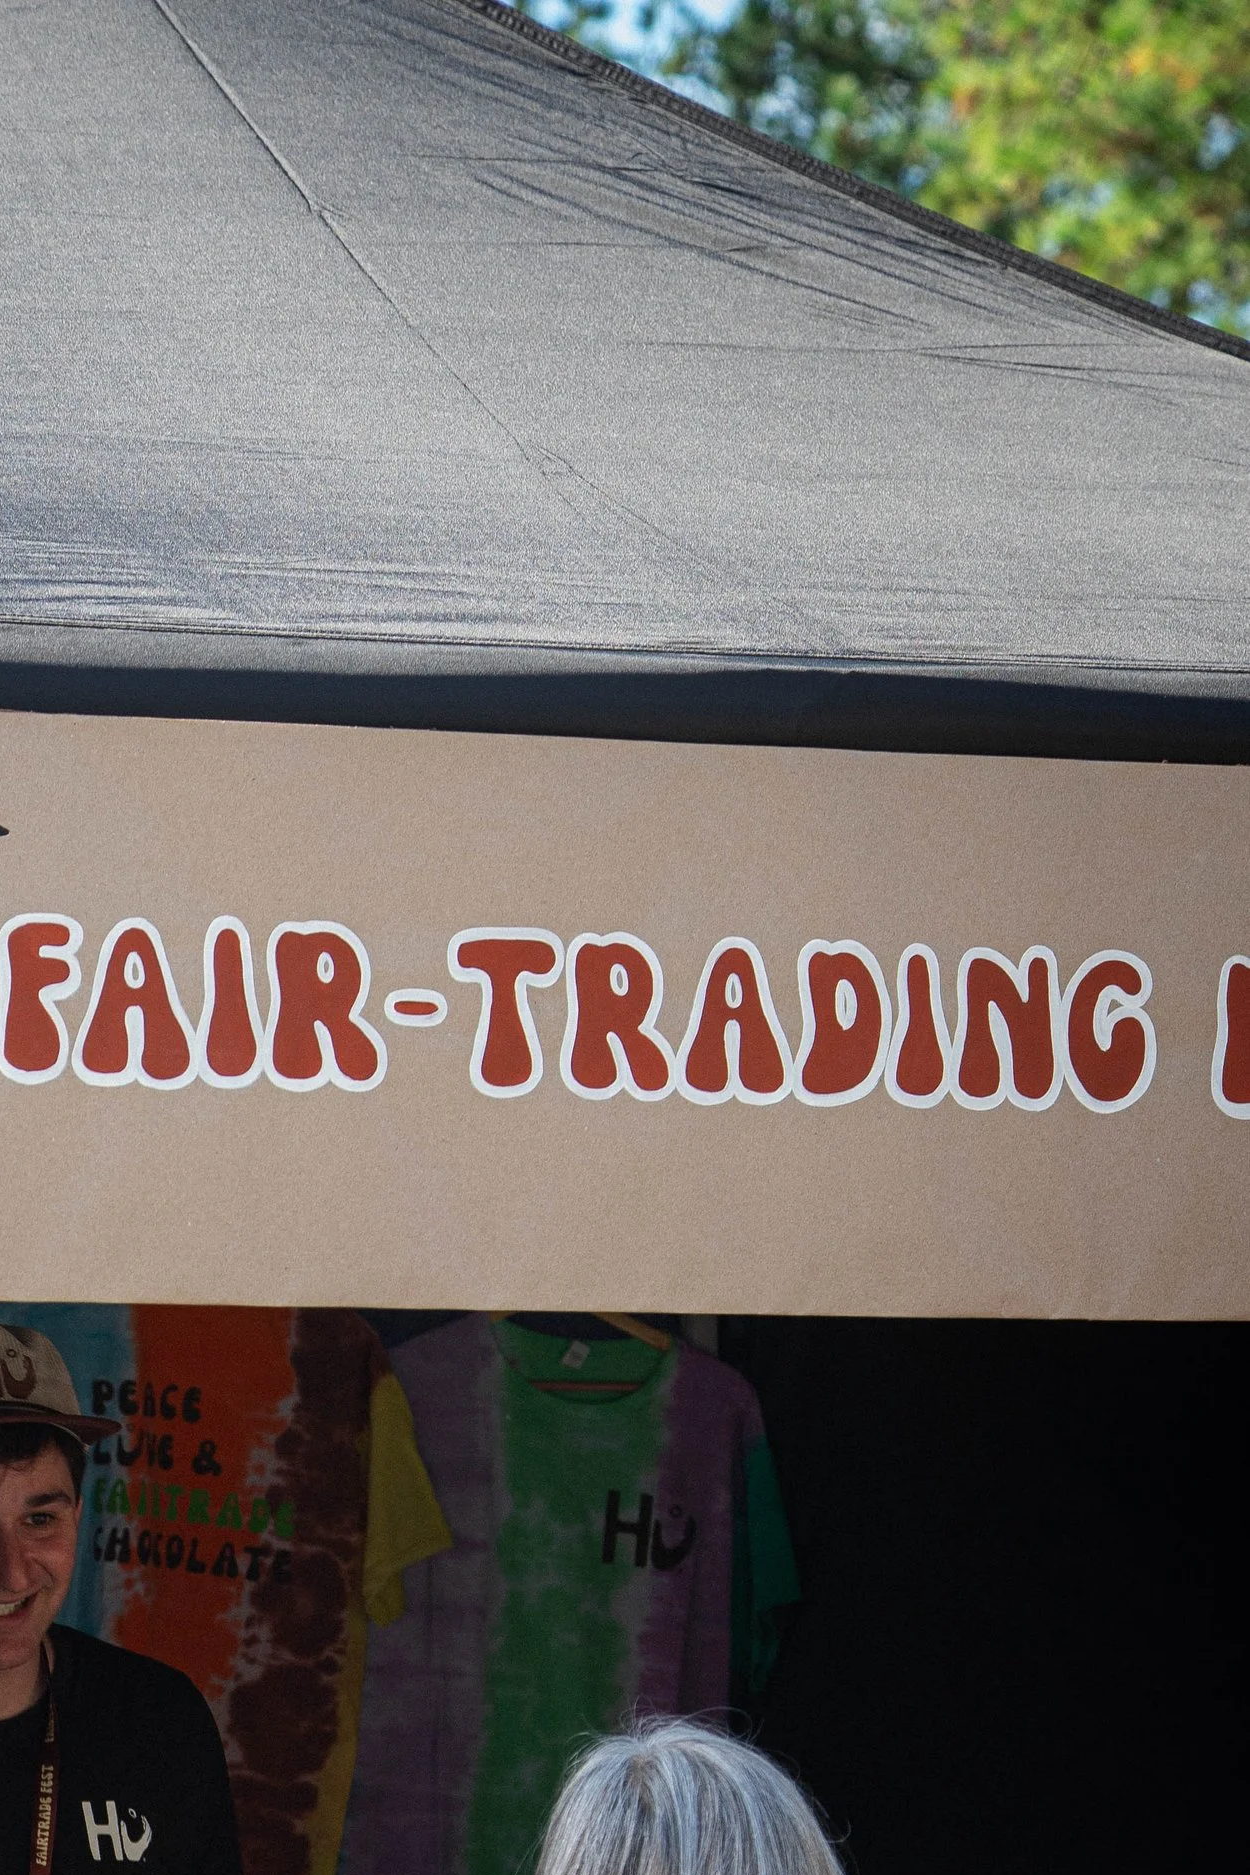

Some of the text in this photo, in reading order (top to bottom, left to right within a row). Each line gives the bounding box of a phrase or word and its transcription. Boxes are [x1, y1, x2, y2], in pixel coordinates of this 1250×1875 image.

[92, 1378, 203, 1424] PEACE
[193, 1440, 222, 1476] &
[93, 1527, 293, 1582] CHOCOLATE
[36, 1764, 54, 1867] FAIRTRADE FEST
